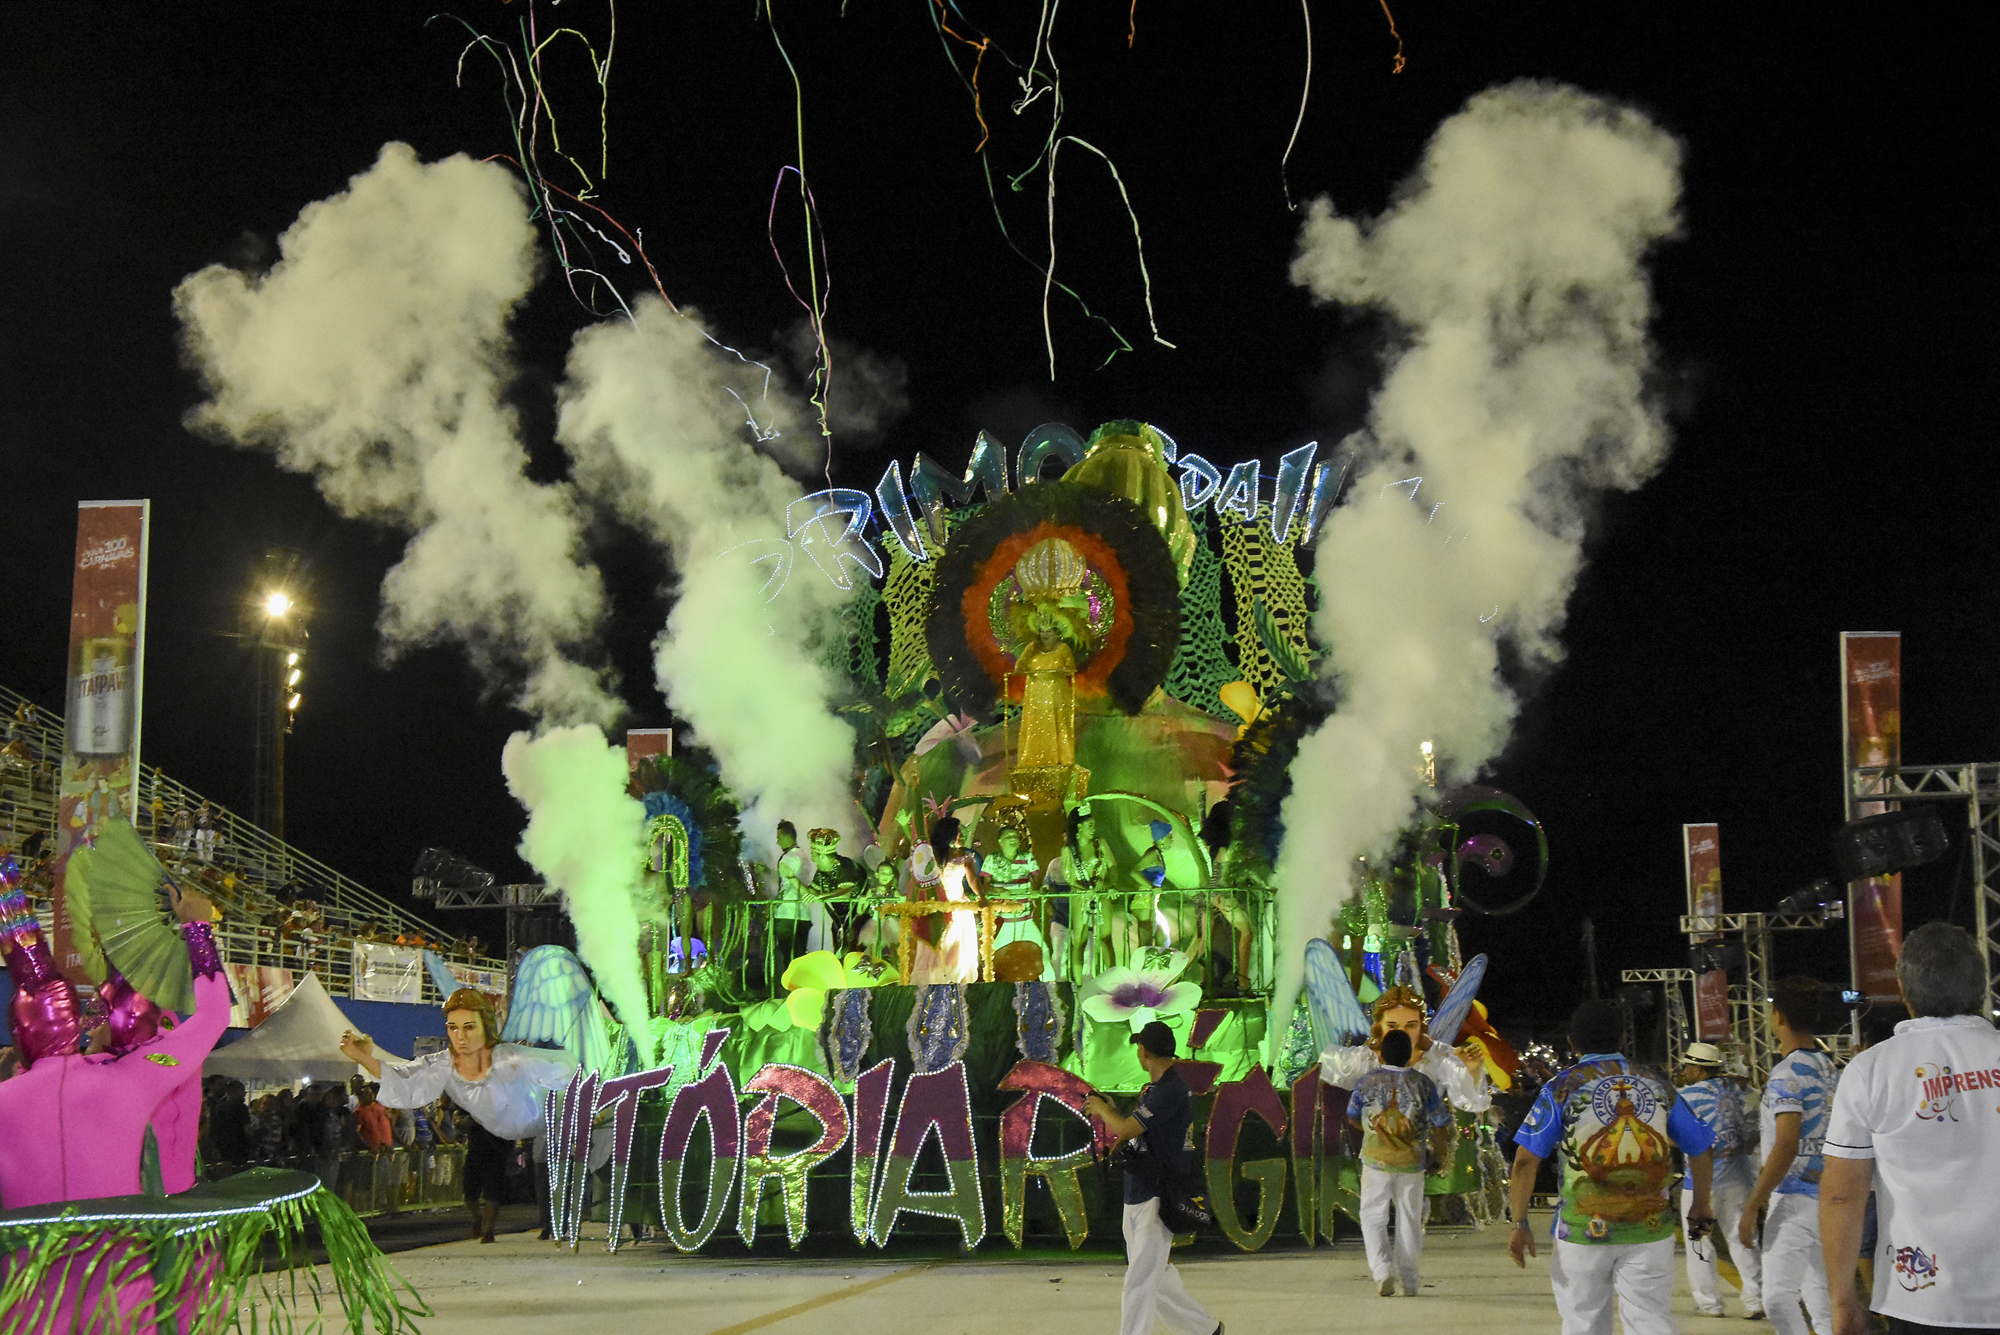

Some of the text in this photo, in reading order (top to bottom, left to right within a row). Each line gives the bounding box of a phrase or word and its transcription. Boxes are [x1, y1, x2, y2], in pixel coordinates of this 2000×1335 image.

[1178, 453, 1261, 521] DA
[104, 537, 127, 553] 100
[1594, 1076, 1655, 1119] PRIMOS DA ILHA
[543, 1027, 986, 1254] VITÓRIA
